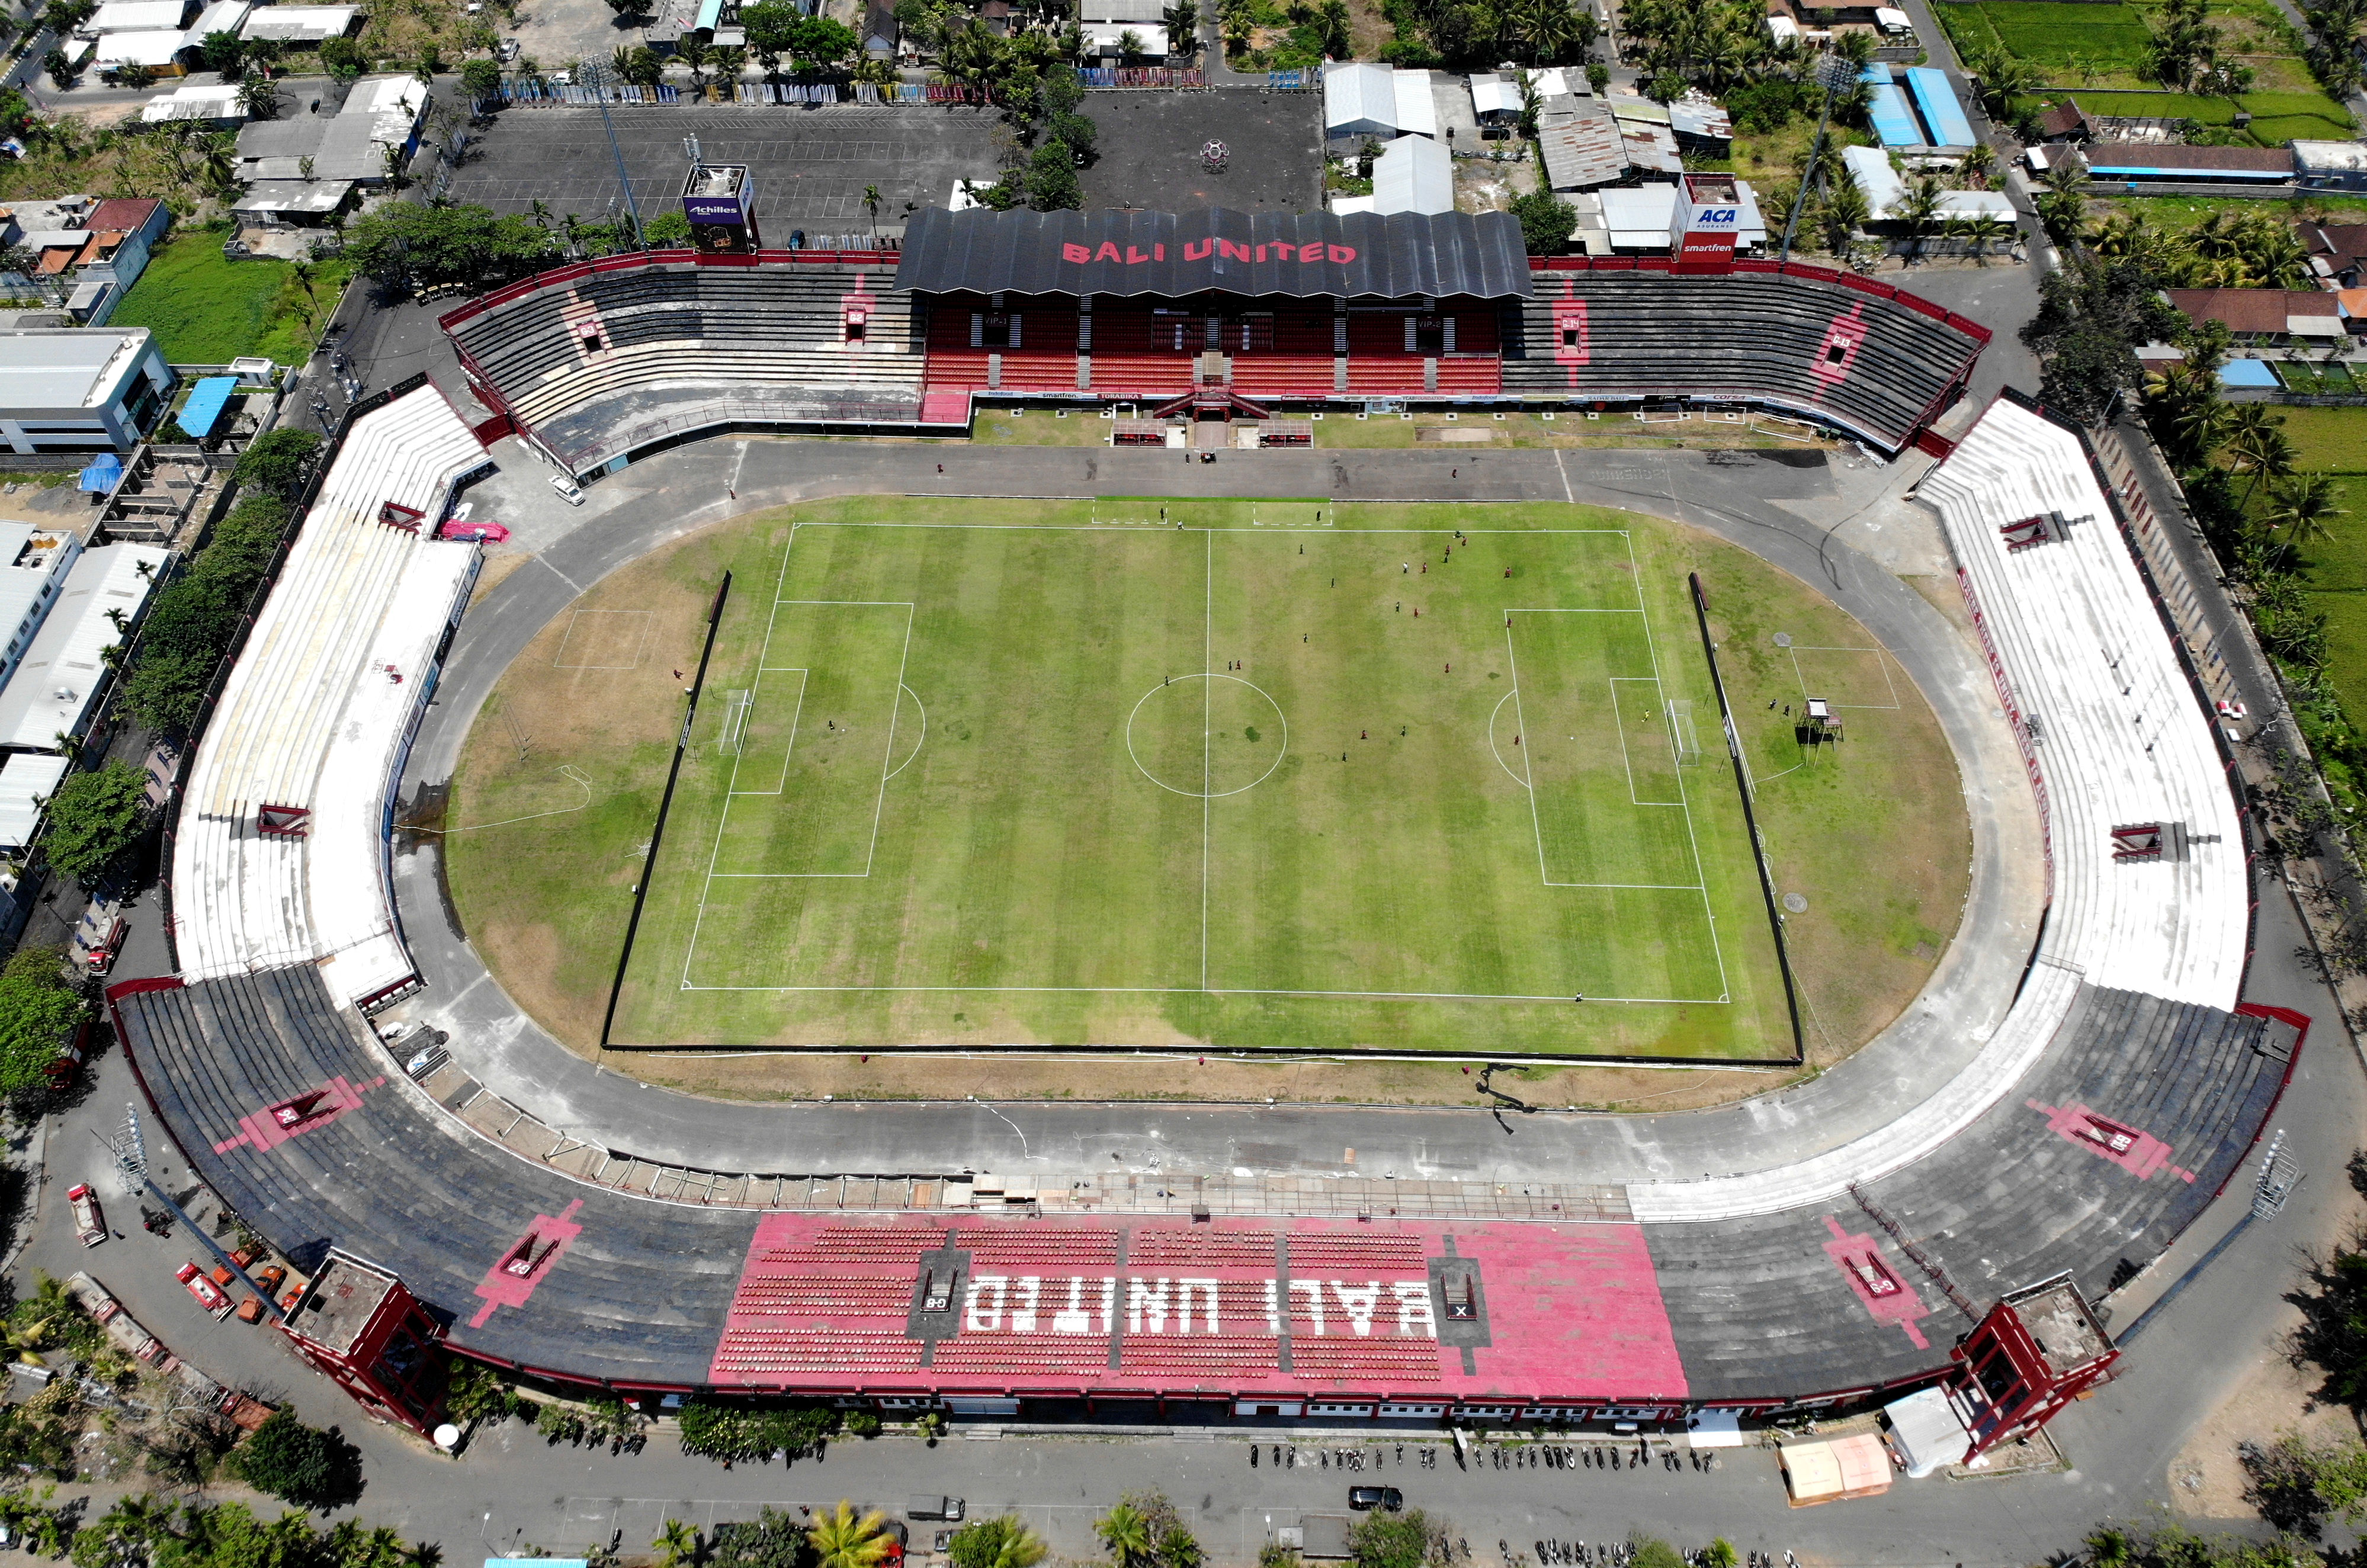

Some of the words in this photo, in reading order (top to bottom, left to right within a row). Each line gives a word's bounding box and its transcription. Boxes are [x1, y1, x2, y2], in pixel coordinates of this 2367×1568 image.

[689, 206, 737, 214] Achilles
[1698, 209, 1736, 222] ACA
[1062, 241, 1165, 265] BALI
[1184, 238, 1358, 265] UNITED
[1684, 243, 1732, 252] smartfren
[850, 313, 863, 322] G-2
[580, 325, 595, 335] G-3
[1833, 335, 1851, 347] G-13
[1977, 616, 1994, 657] THERE
[926, 1298, 947, 1308] G-8
[964, 1276, 1219, 1333] UNITED
[1265, 1279, 1437, 1338] BALI
